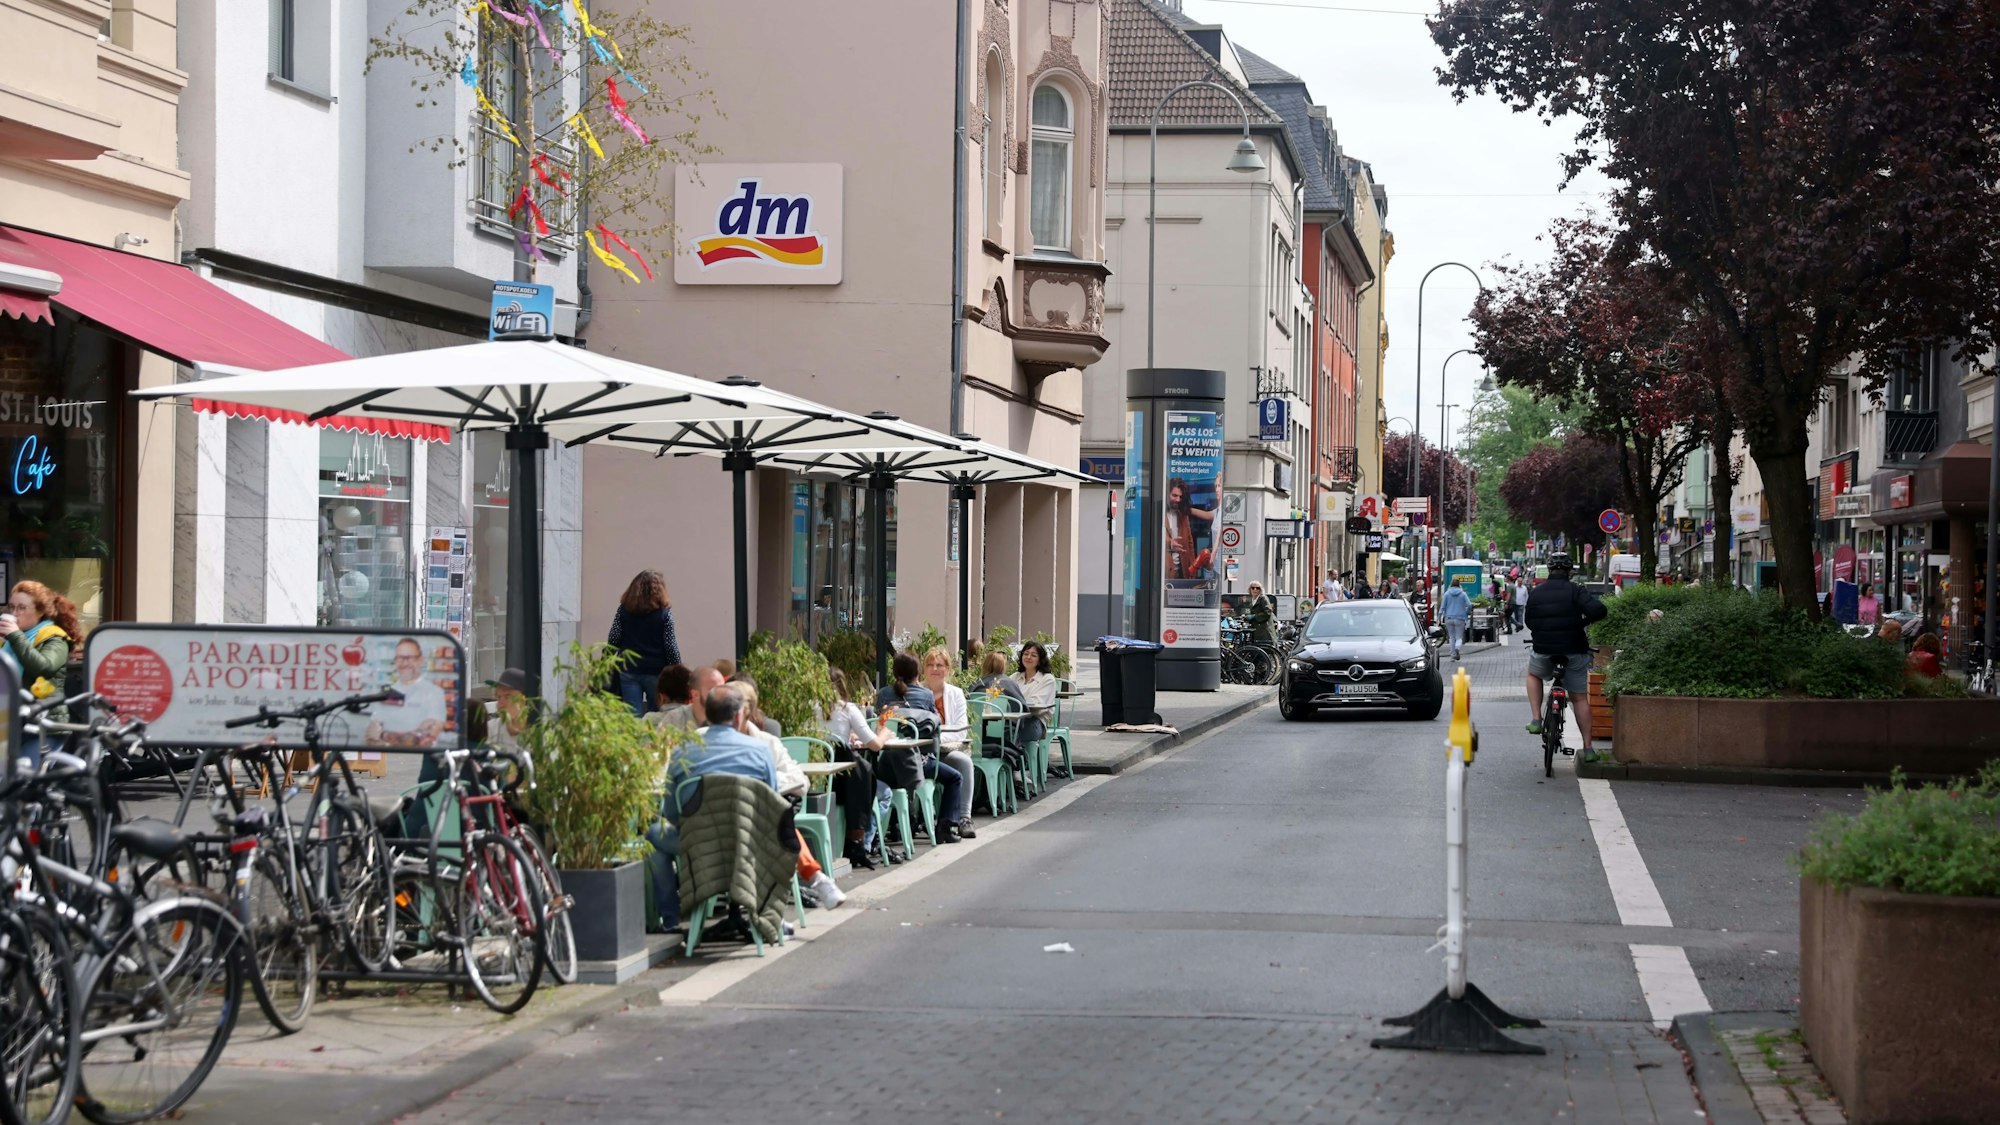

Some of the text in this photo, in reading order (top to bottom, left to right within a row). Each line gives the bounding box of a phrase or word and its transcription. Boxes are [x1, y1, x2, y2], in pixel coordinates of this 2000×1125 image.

[719, 181, 809, 235] dm
[0, 391, 93, 429] ST. LOUIS
[1171, 427, 1197, 436] LASS
[1260, 425, 1283, 434] HOTEL
[1171, 437, 1200, 446] AUCH
[1171, 447, 1220, 457] ES WEHTUT
[14, 434, 57, 495] Café
[1171, 459, 1197, 467] Entsorge
[1225, 532, 1237, 542] 30
[187, 641, 338, 666] PARADIES
[181, 666, 363, 691] APOTHEKE
